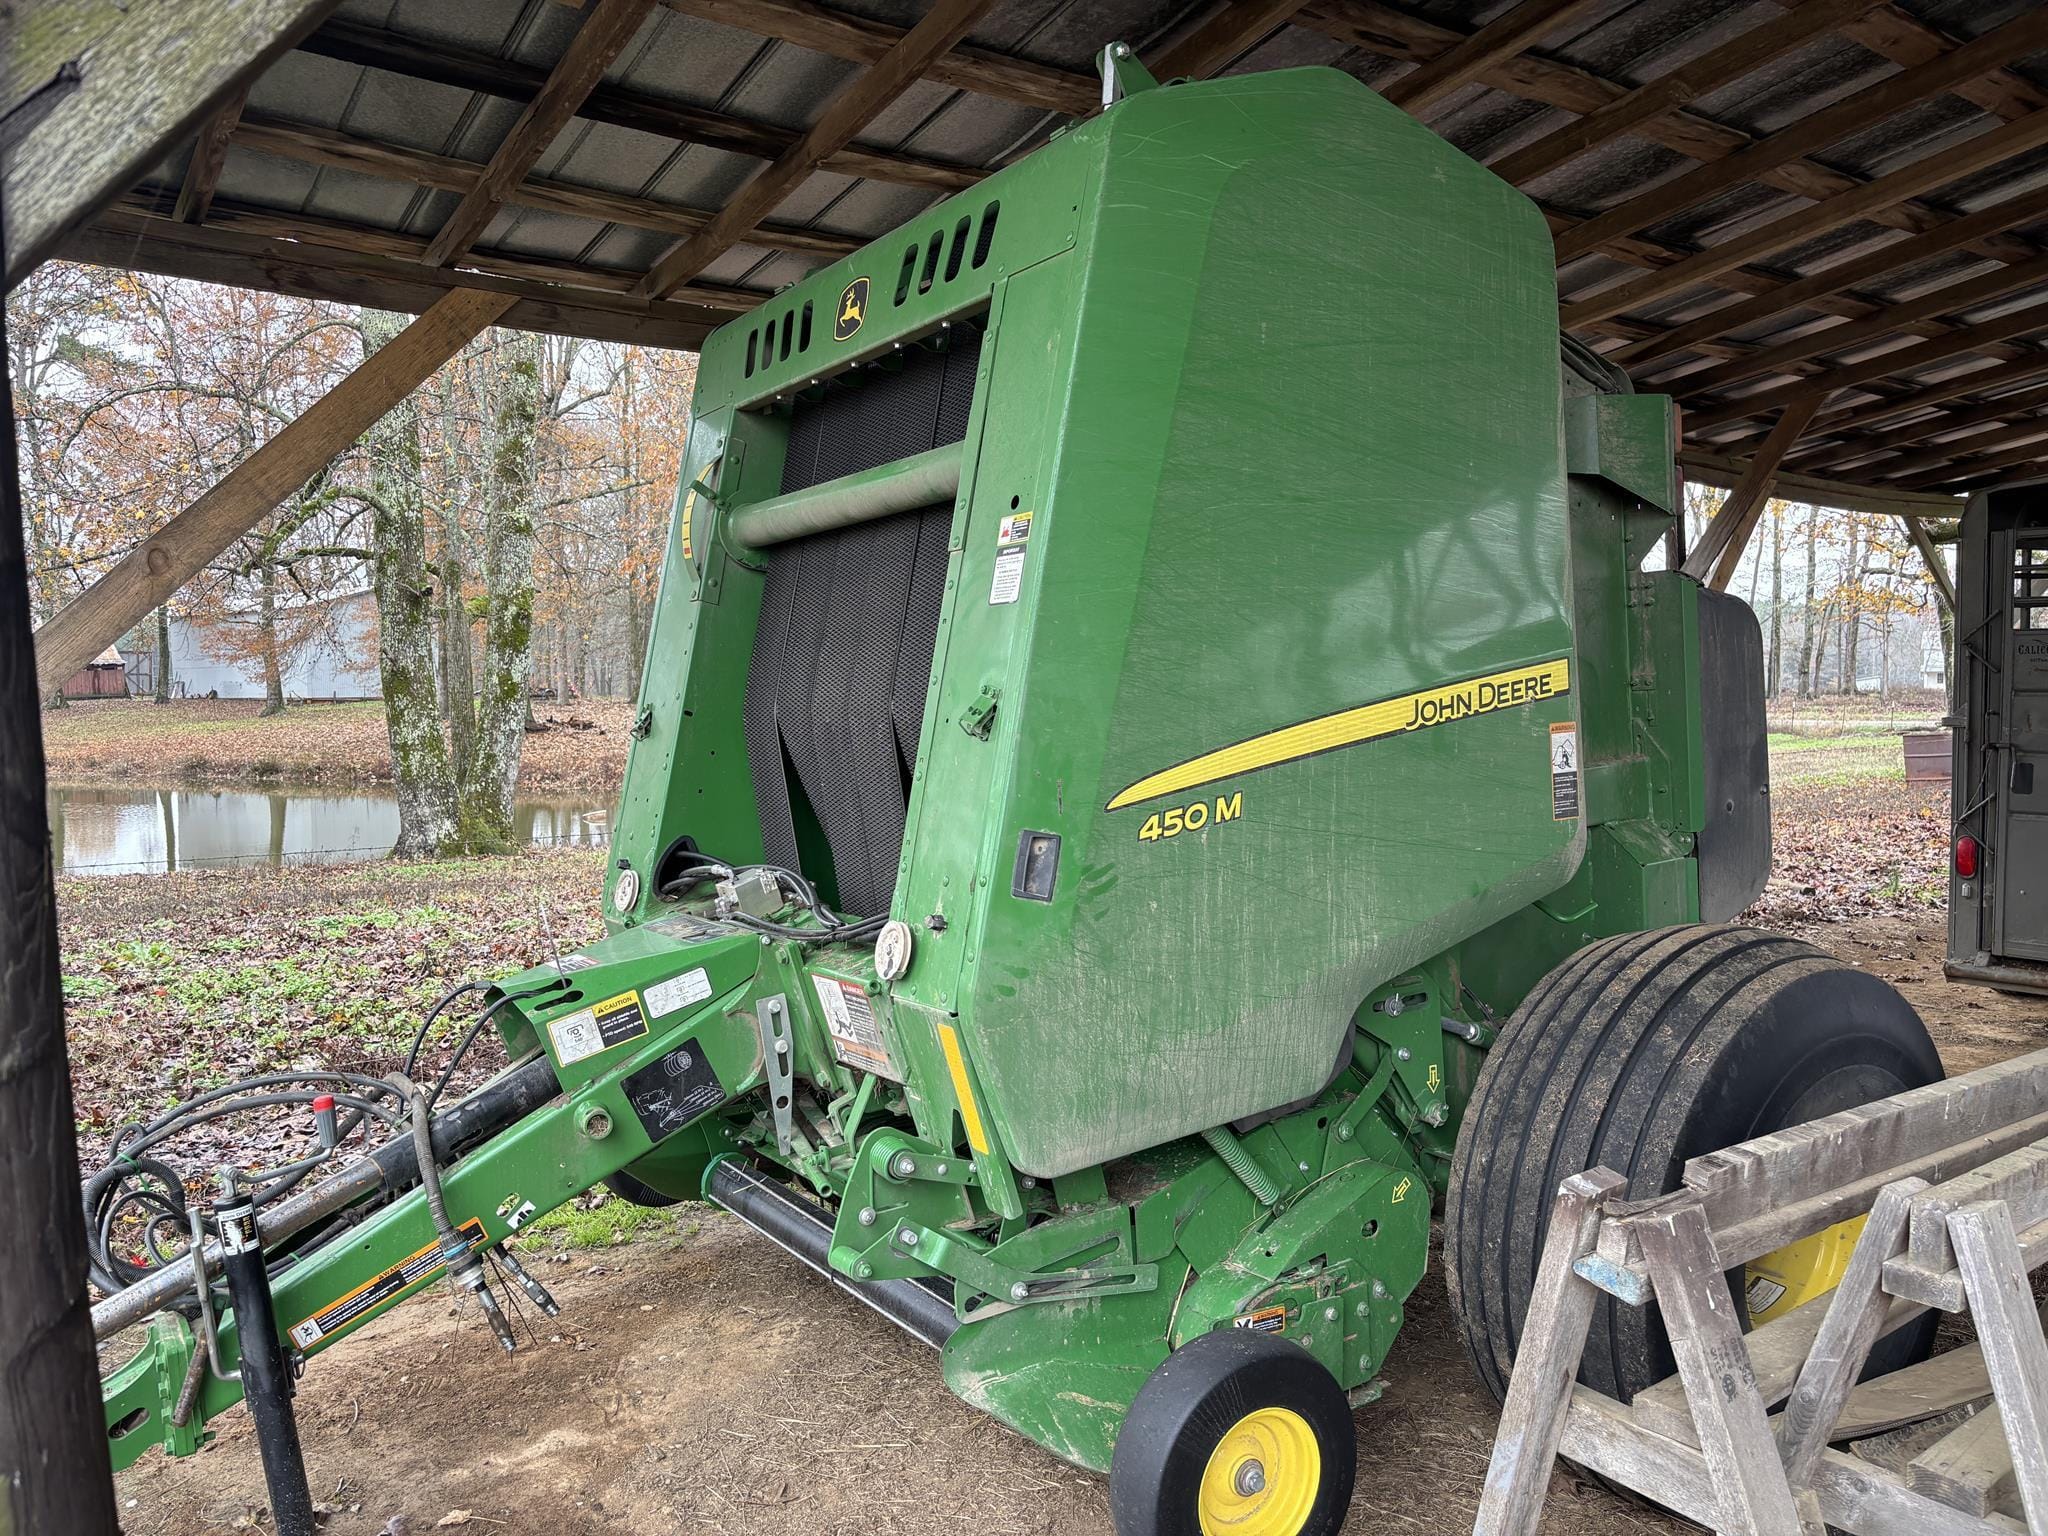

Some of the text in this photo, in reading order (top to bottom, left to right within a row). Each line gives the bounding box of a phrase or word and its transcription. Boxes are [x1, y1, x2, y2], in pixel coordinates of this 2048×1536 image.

[1406, 673, 1552, 728] JOHN DEERE
[1137, 790, 1243, 843] 450 M
[603, 996, 632, 1011] CAUTION
[382, 1256, 415, 1277] WARNING
